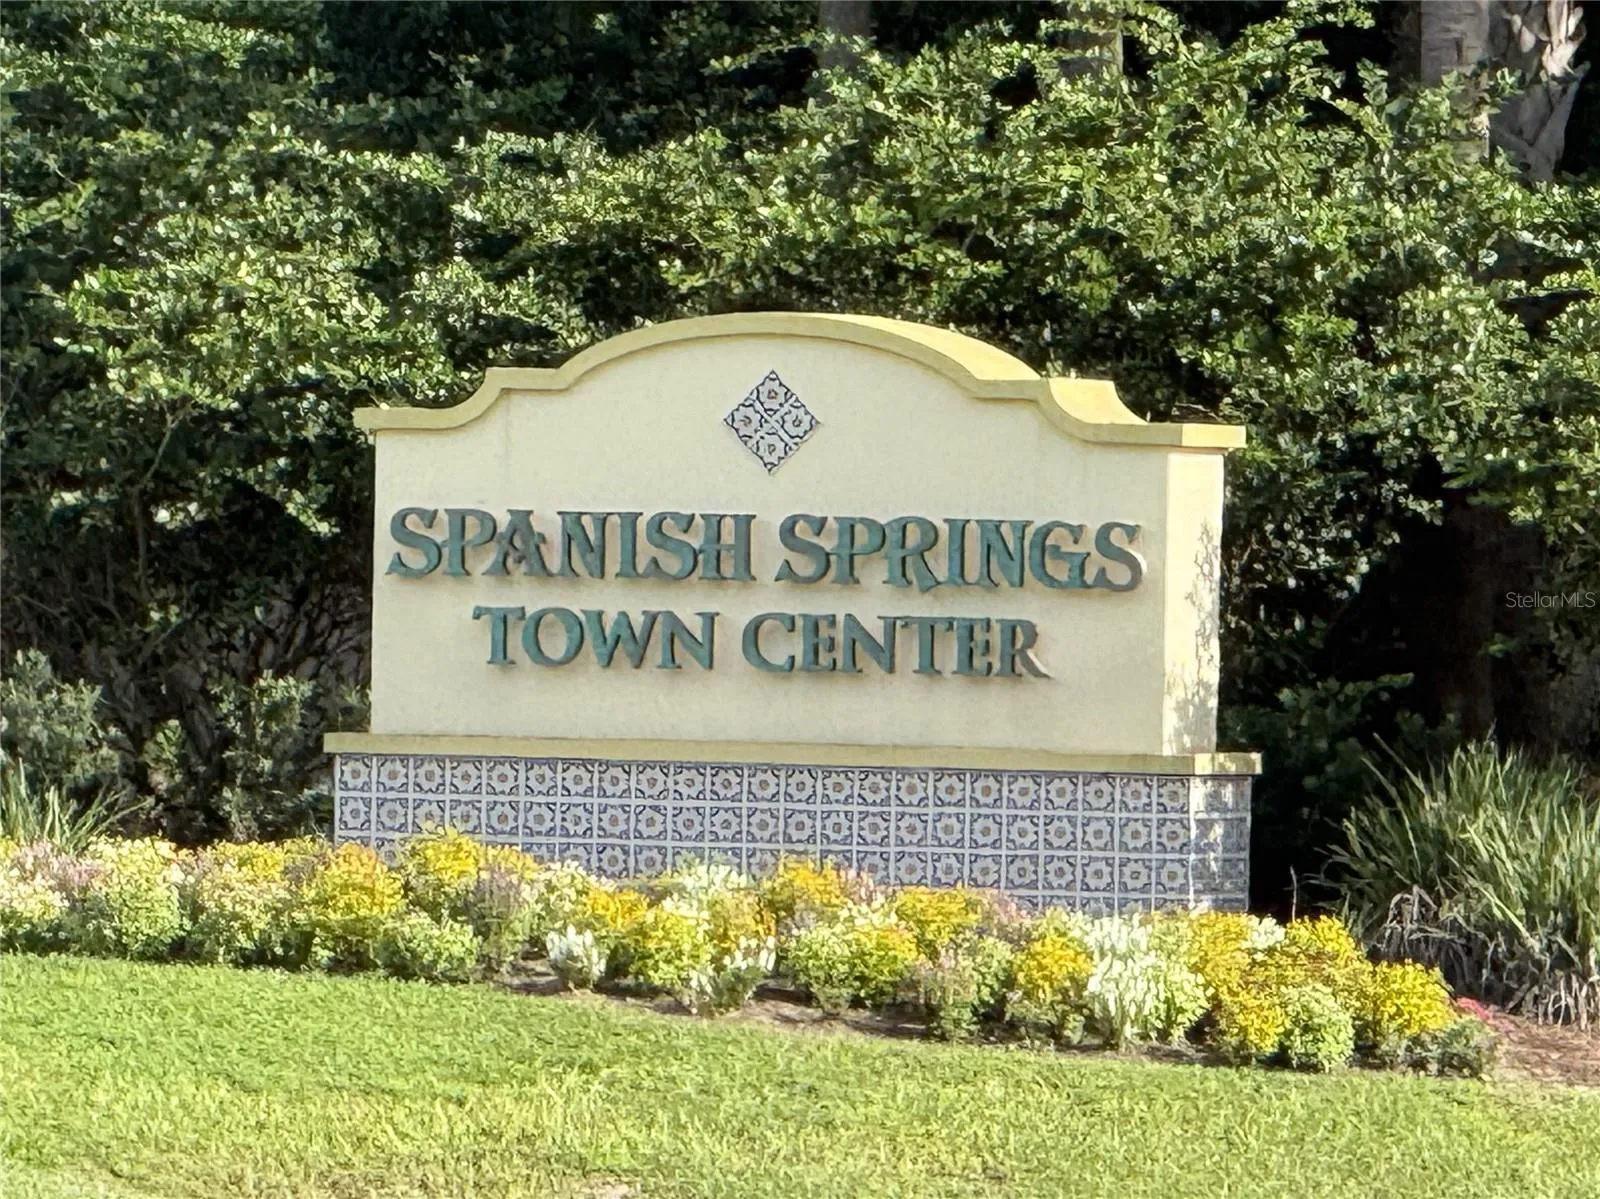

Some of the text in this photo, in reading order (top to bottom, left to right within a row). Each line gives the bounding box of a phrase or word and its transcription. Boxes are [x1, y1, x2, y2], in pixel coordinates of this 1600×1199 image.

[385, 507, 1146, 592] SPANISH SPRINGS
[472, 605, 1051, 679] TOWN CENTER
